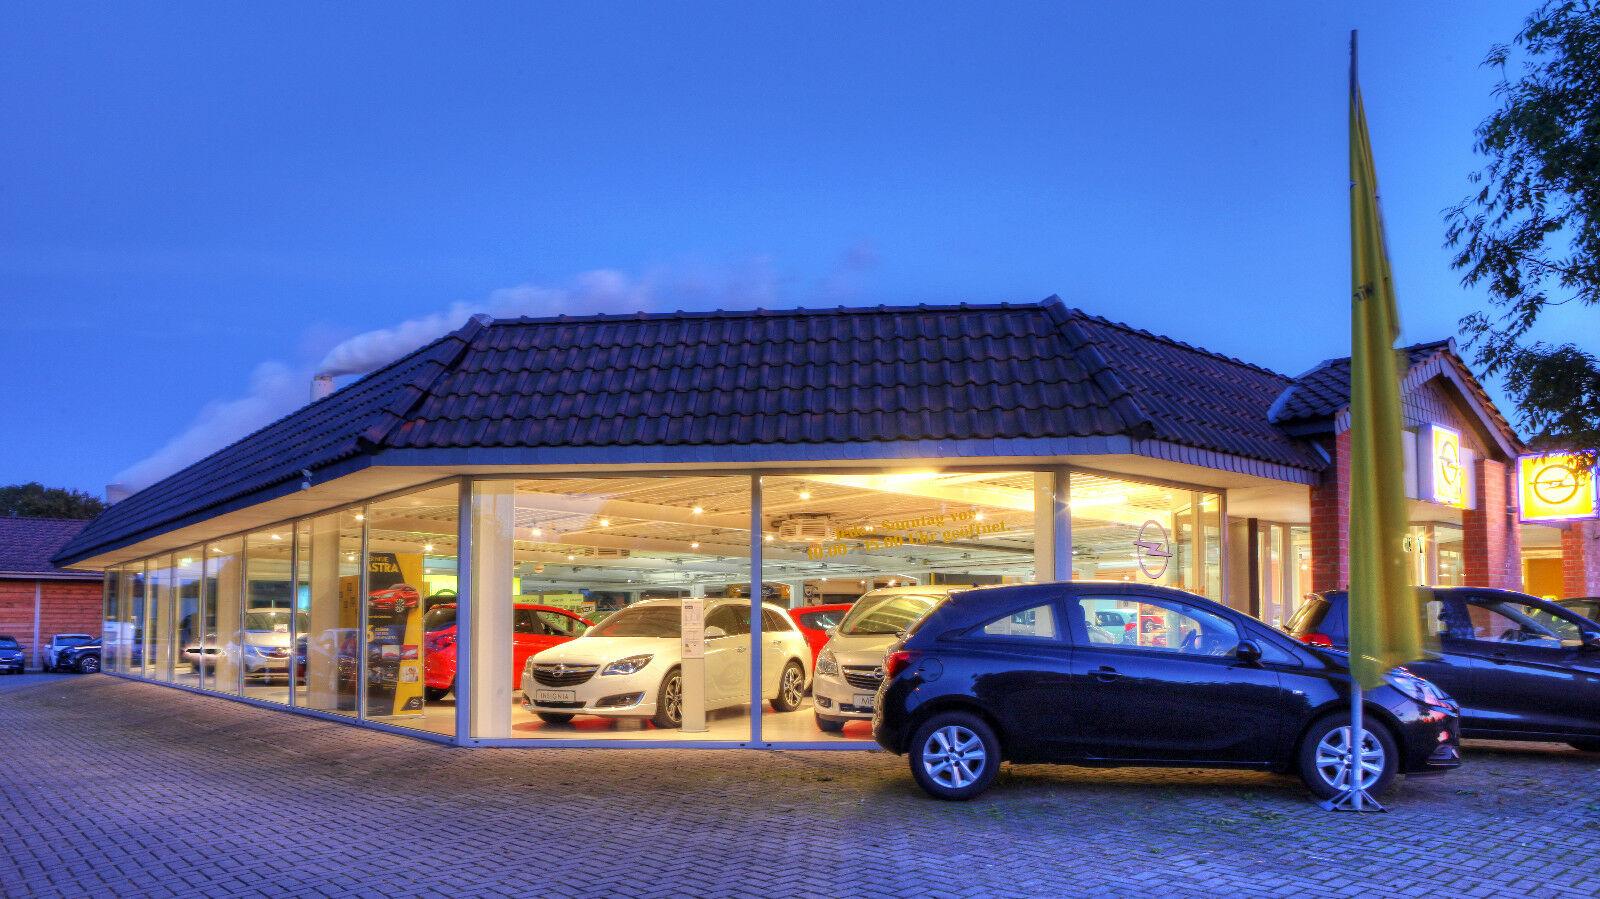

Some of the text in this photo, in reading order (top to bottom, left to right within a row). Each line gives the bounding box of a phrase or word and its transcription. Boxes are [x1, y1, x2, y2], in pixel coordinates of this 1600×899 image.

[881, 515, 944, 532] Sonntag
[950, 509, 976, 522] von
[807, 543, 847, 560] 10.00
